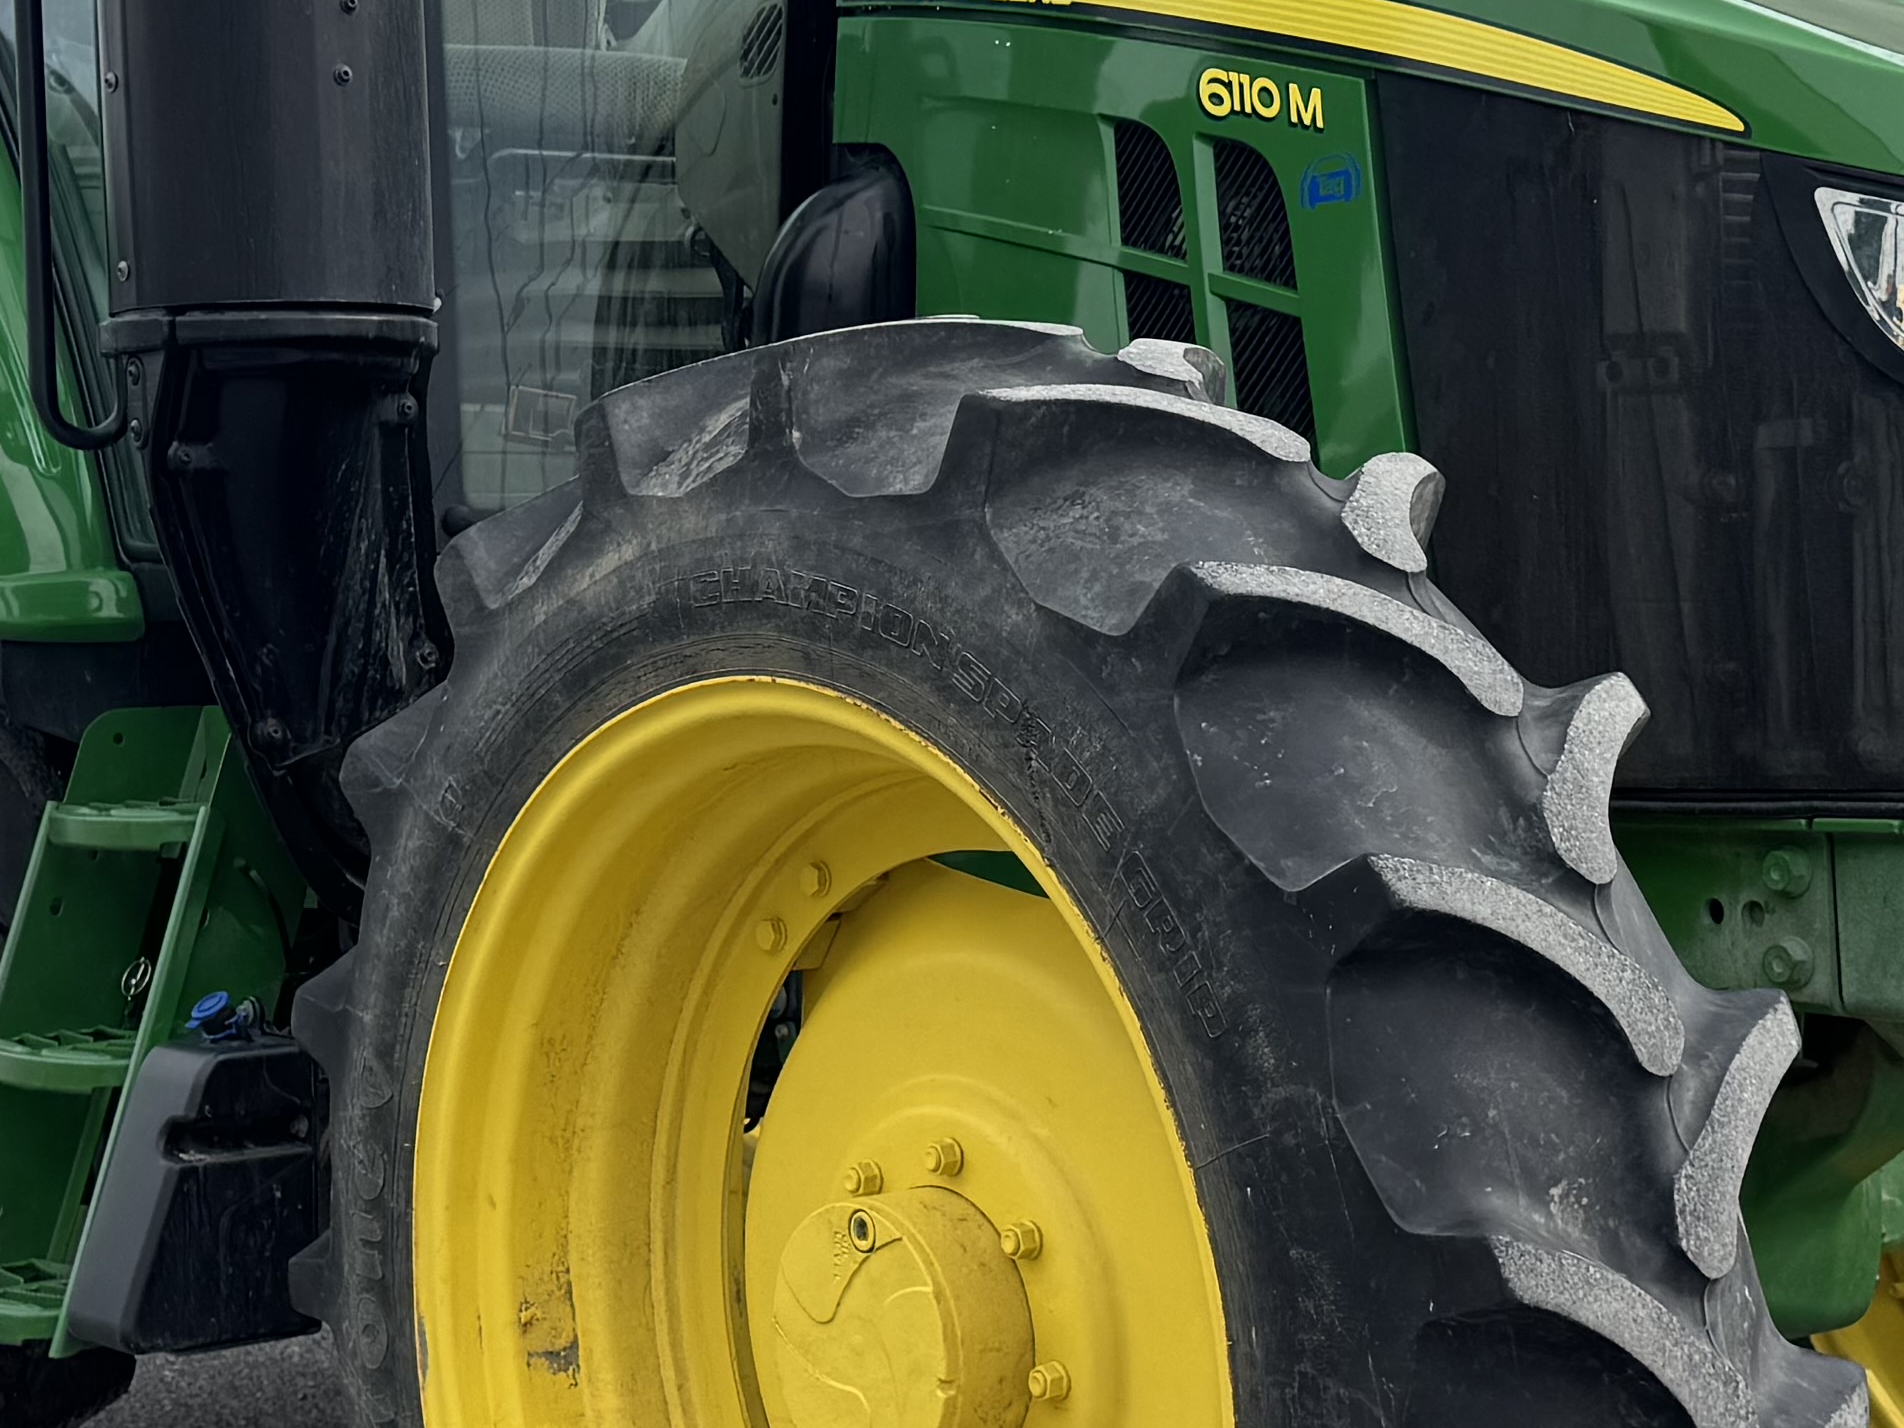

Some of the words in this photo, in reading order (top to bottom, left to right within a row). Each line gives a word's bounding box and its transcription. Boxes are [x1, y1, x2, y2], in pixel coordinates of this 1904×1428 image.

[1199, 68, 1281, 119] 6110
[1288, 83, 1325, 130] M
[690, 566, 951, 671] CHAMPION
[1119, 850, 1229, 1038] GRIP
